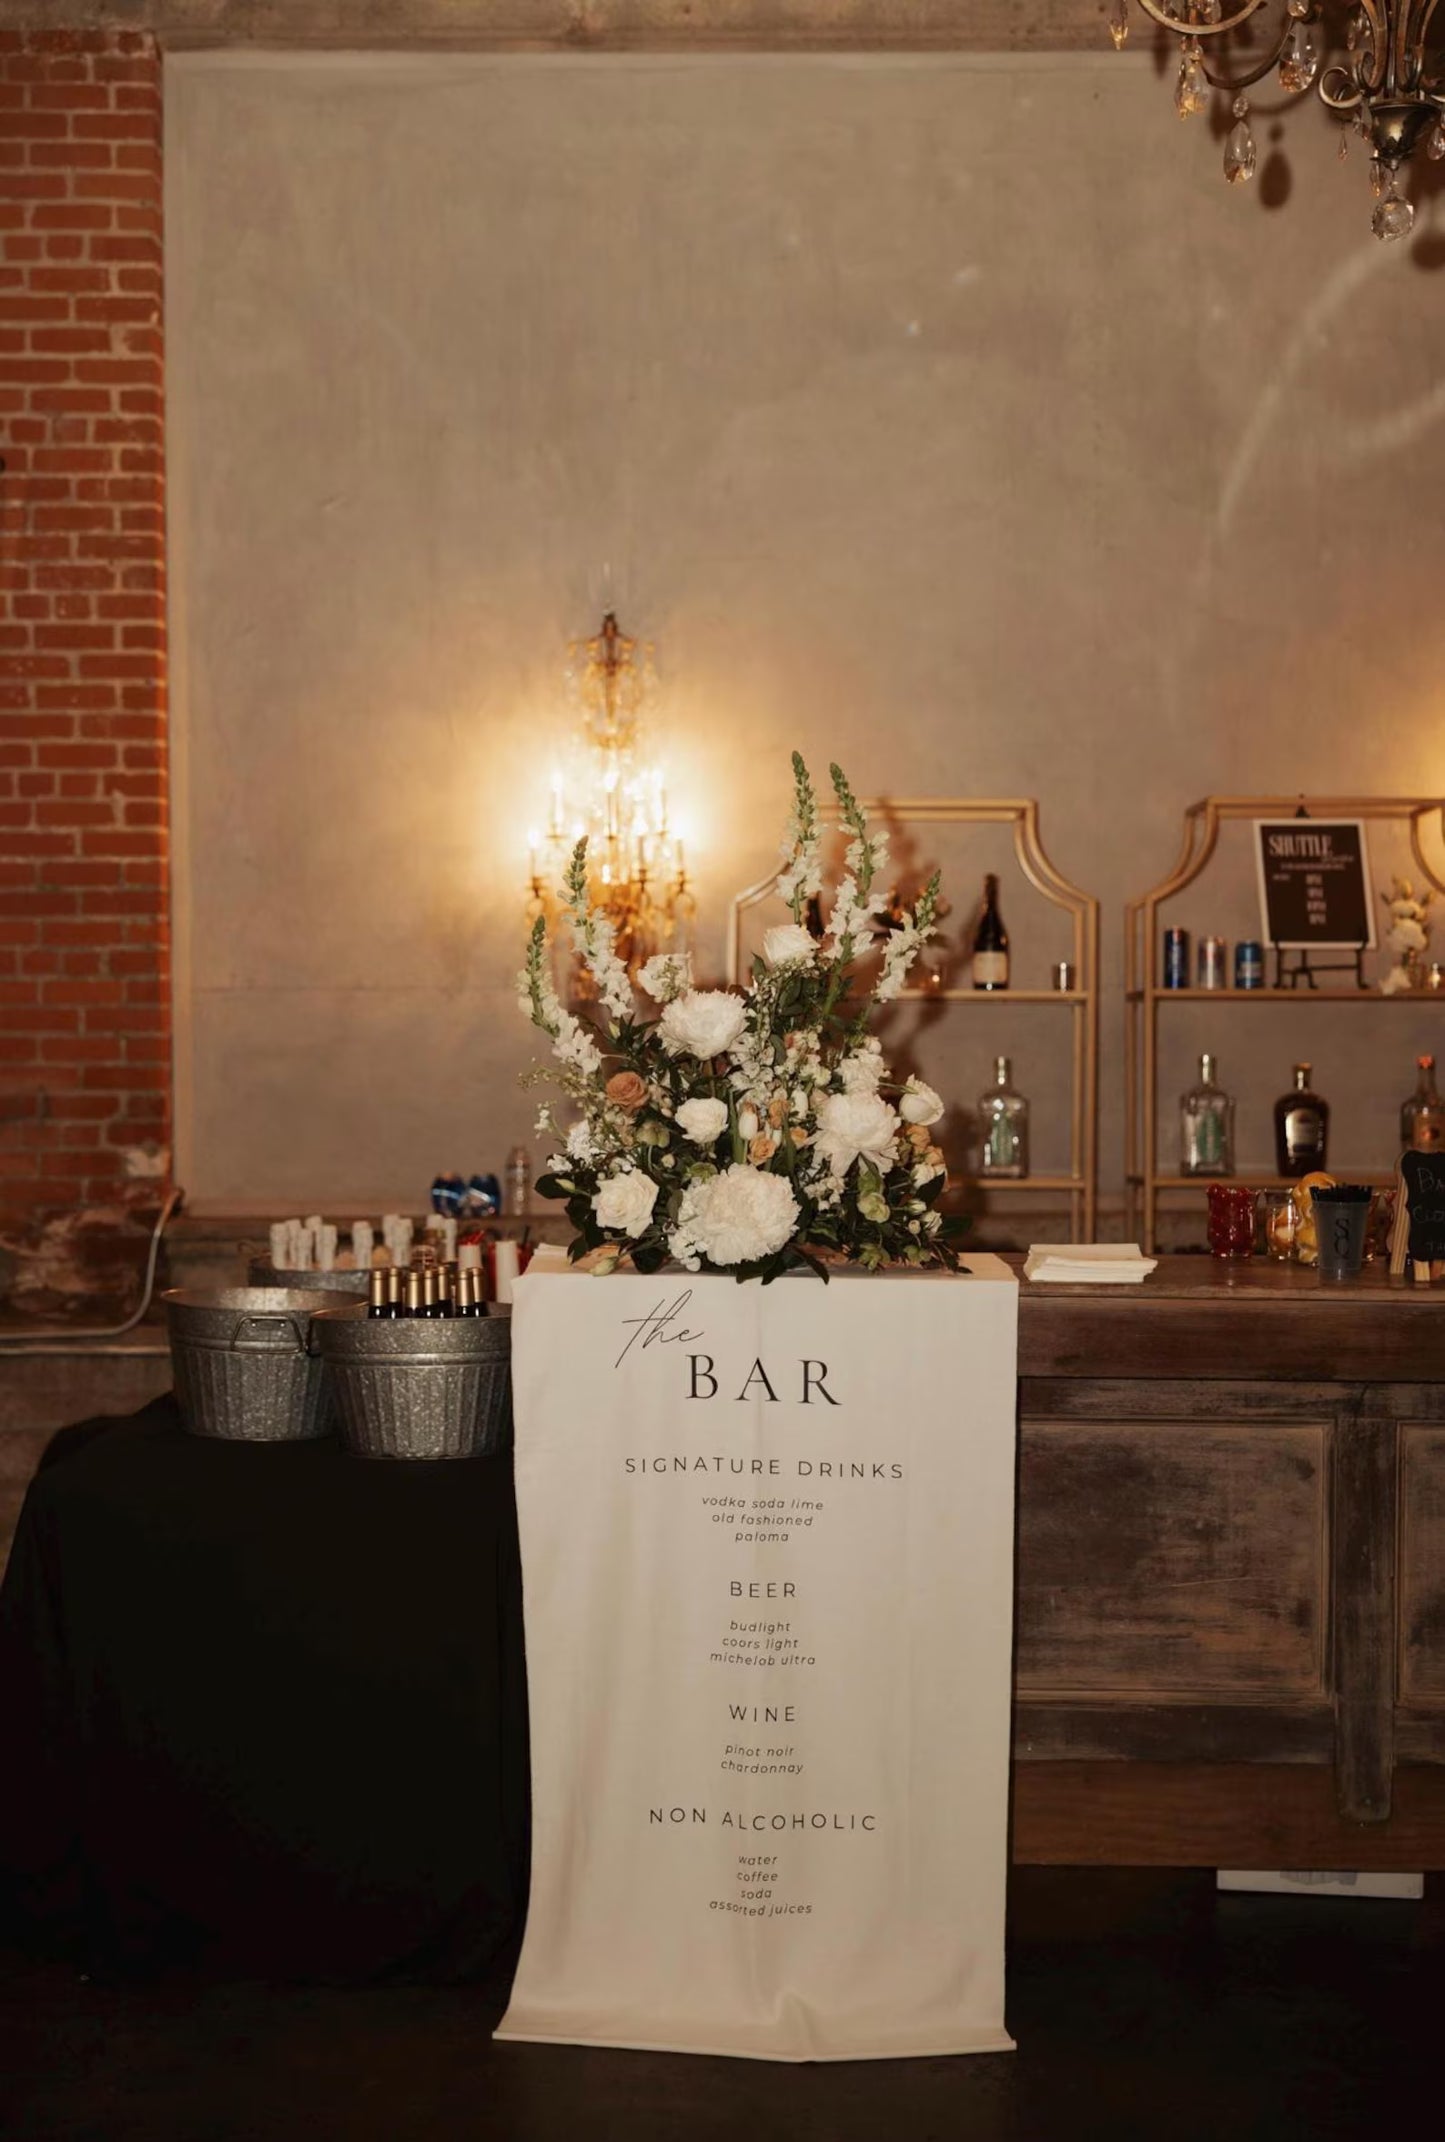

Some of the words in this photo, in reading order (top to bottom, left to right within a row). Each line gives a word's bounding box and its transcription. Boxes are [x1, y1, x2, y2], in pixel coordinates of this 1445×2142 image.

[1268, 833, 1333, 857] SHUTTLE
[615, 1289, 704, 1369] the
[685, 1354, 842, 1406] BAR
[625, 1456, 781, 1475] SIGNATURE
[797, 1460, 903, 1479] DRINKS
[702, 1495, 746, 1508] vodka
[751, 1497, 786, 1510] soda
[790, 1498, 824, 1511] lime
[711, 1512, 735, 1524] old
[740, 1513, 814, 1527] fashioned
[734, 1531, 789, 1543] paloma
[730, 1580, 797, 1599] BEER
[729, 1620, 791, 1636] budlight
[722, 1638, 761, 1650] coors
[765, 1638, 799, 1652] light
[710, 1652, 776, 1666] michelob
[780, 1654, 816, 1666] ultra
[728, 1704, 796, 1723] WINE
[724, 1743, 761, 1758] pinot
[766, 1746, 794, 1757] noir
[720, 1758, 804, 1775] chardonnay
[649, 1807, 706, 1824] NON
[721, 1811, 876, 1831] ALCOHOLIC
[738, 1855, 778, 1866] water
[736, 1870, 778, 1883] coffee
[740, 1887, 772, 1900] soda
[709, 1900, 766, 1917] assorted
[767, 1903, 812, 1918] juices
